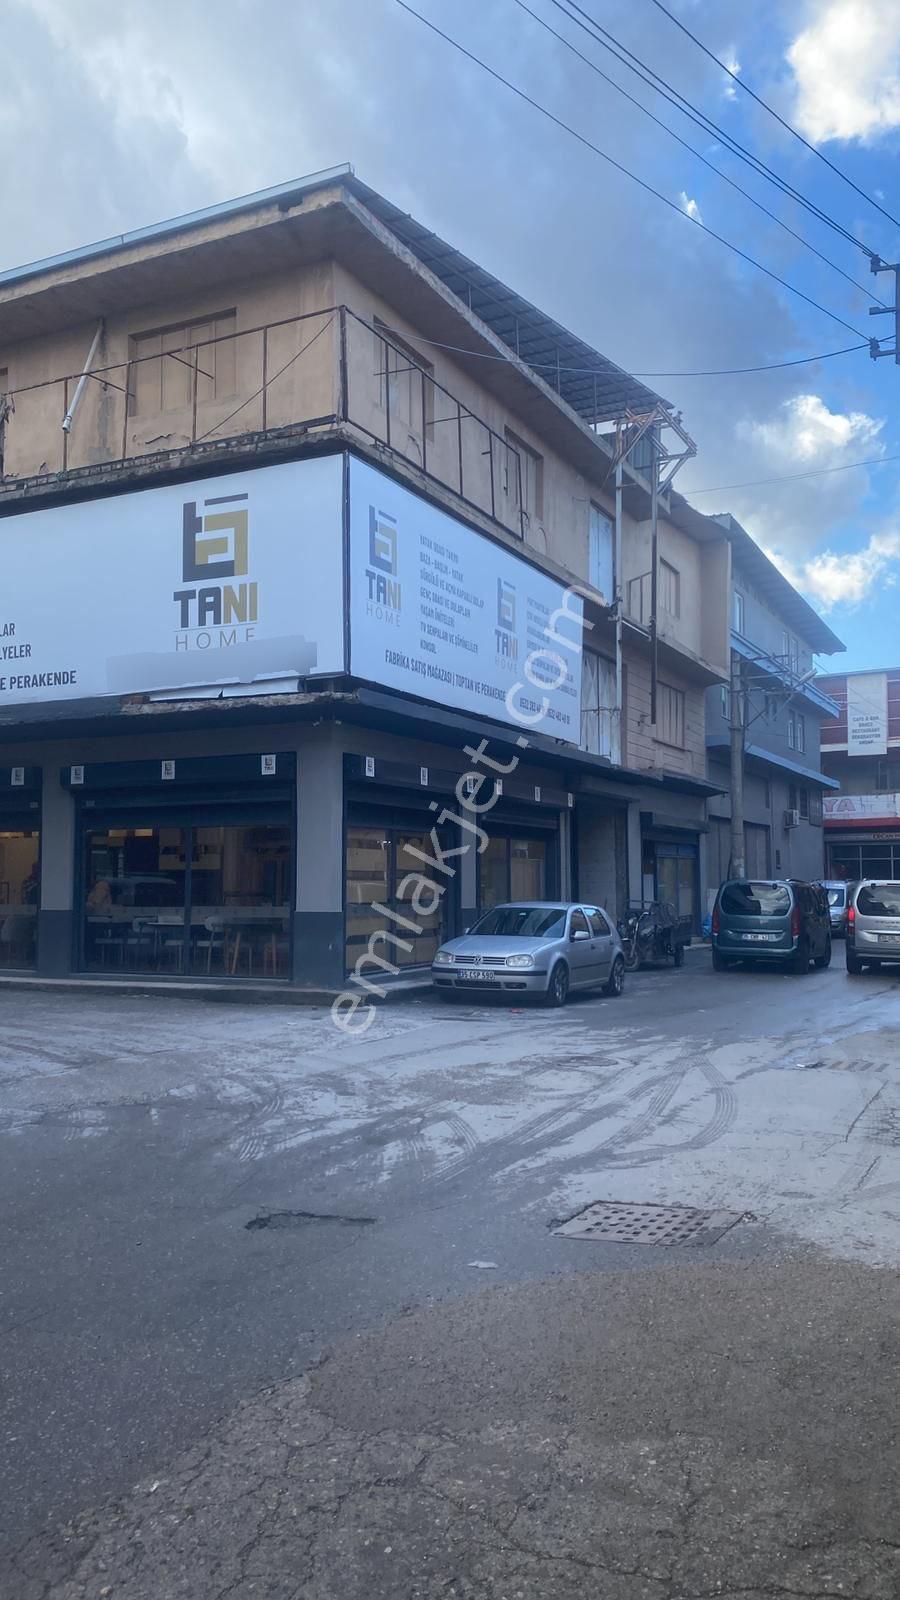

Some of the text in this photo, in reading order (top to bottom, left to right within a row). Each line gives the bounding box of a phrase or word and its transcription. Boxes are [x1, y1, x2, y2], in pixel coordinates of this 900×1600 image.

[173, 582, 258, 629] TANI
[365, 569, 401, 611] TANI
[366, 601, 401, 628] HOME
[495, 629, 518, 660] TANI
[10, 670, 77, 690] PERAKENDE
[384, 650, 410, 671] FABRİKA
[410, 658, 426, 678] SATIŞ
[427, 663, 452, 684] MAĞAZASI
[455, 674, 473, 691] TOPTAN
[474, 680, 481, 694] VE
